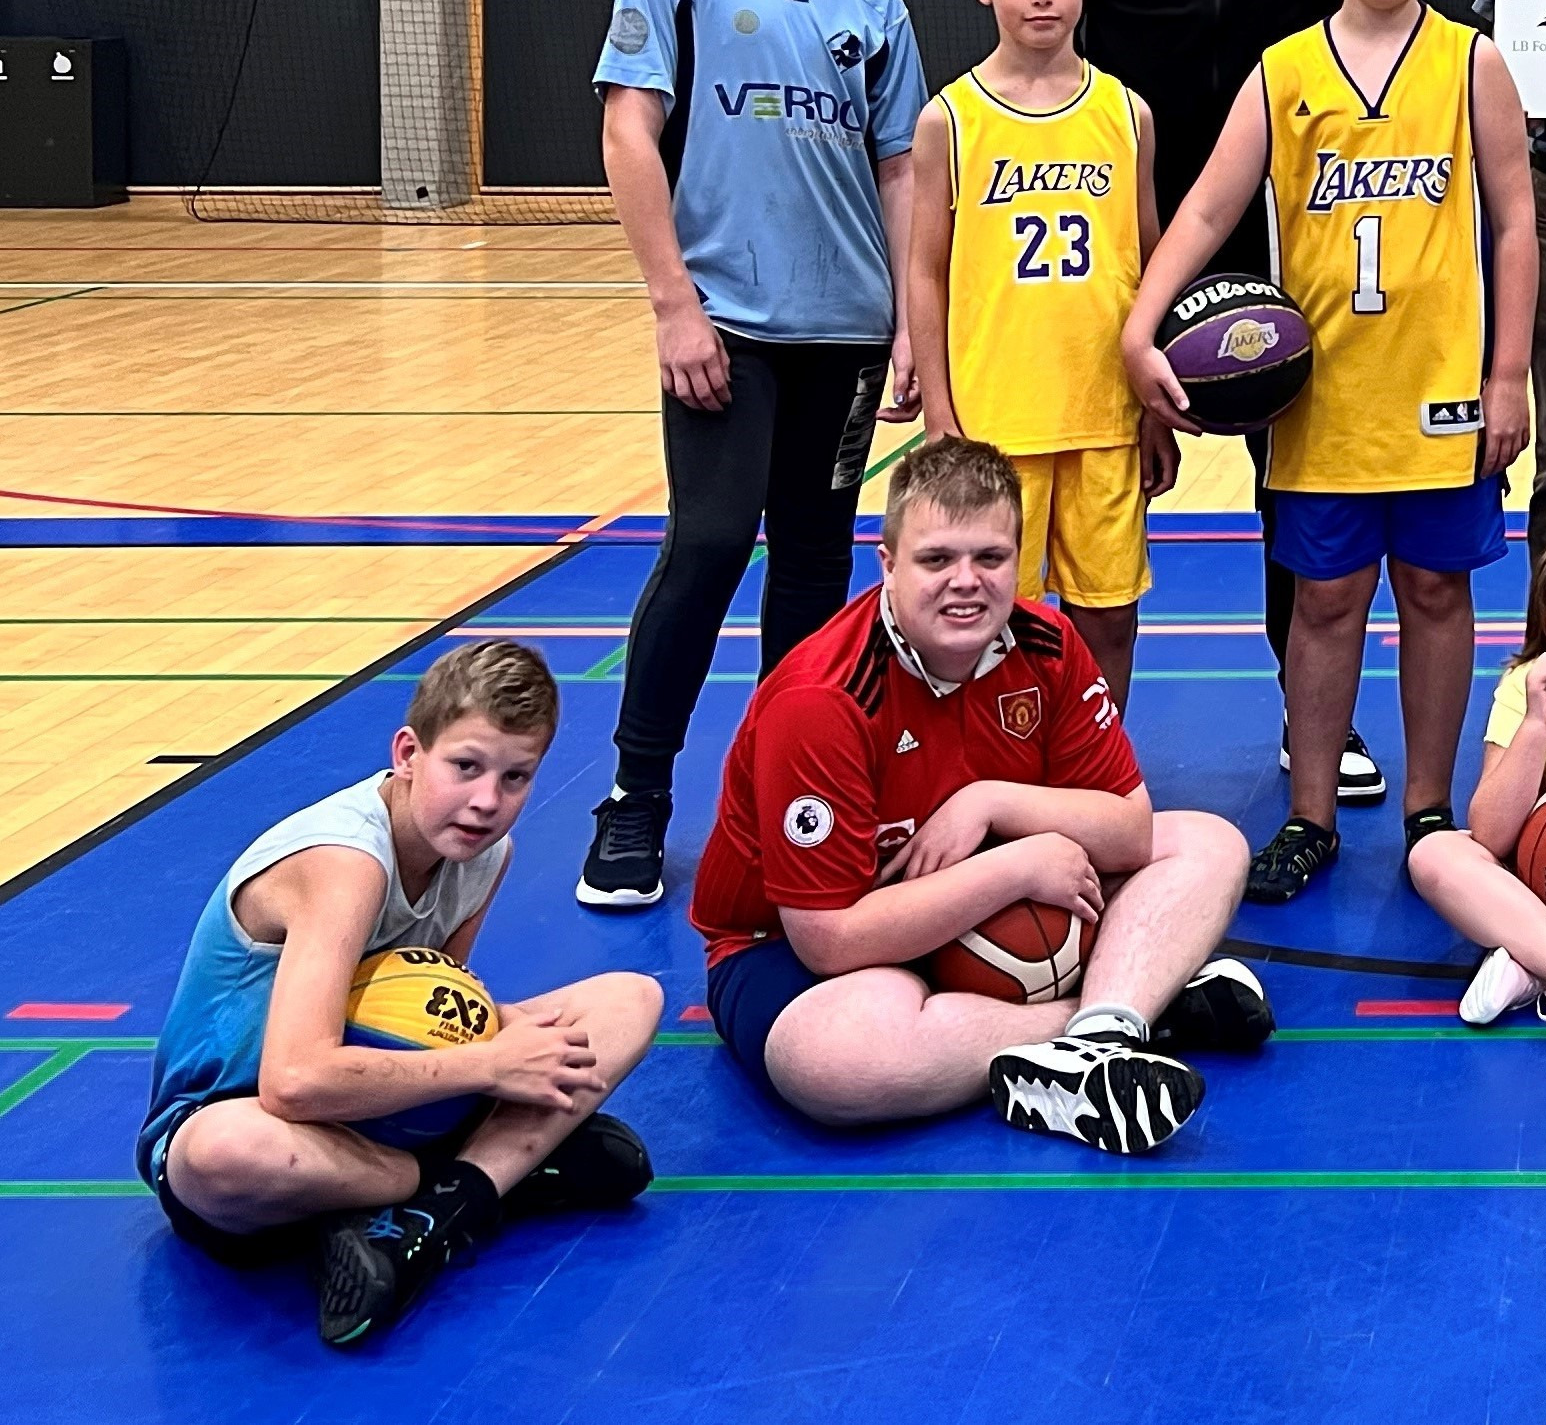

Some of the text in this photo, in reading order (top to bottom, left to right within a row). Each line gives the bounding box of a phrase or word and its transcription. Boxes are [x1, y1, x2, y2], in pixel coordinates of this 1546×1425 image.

[1512, 40, 1529, 52] LB
[713, 82, 864, 133] VERDO
[979, 158, 1113, 206] LAKERS
[1306, 151, 1453, 214] LAKERS
[1014, 213, 1091, 280] 23
[1351, 214, 1387, 315] 1
[1172, 280, 1285, 321] Wilson
[1219, 329, 1275, 357] LAKERS
